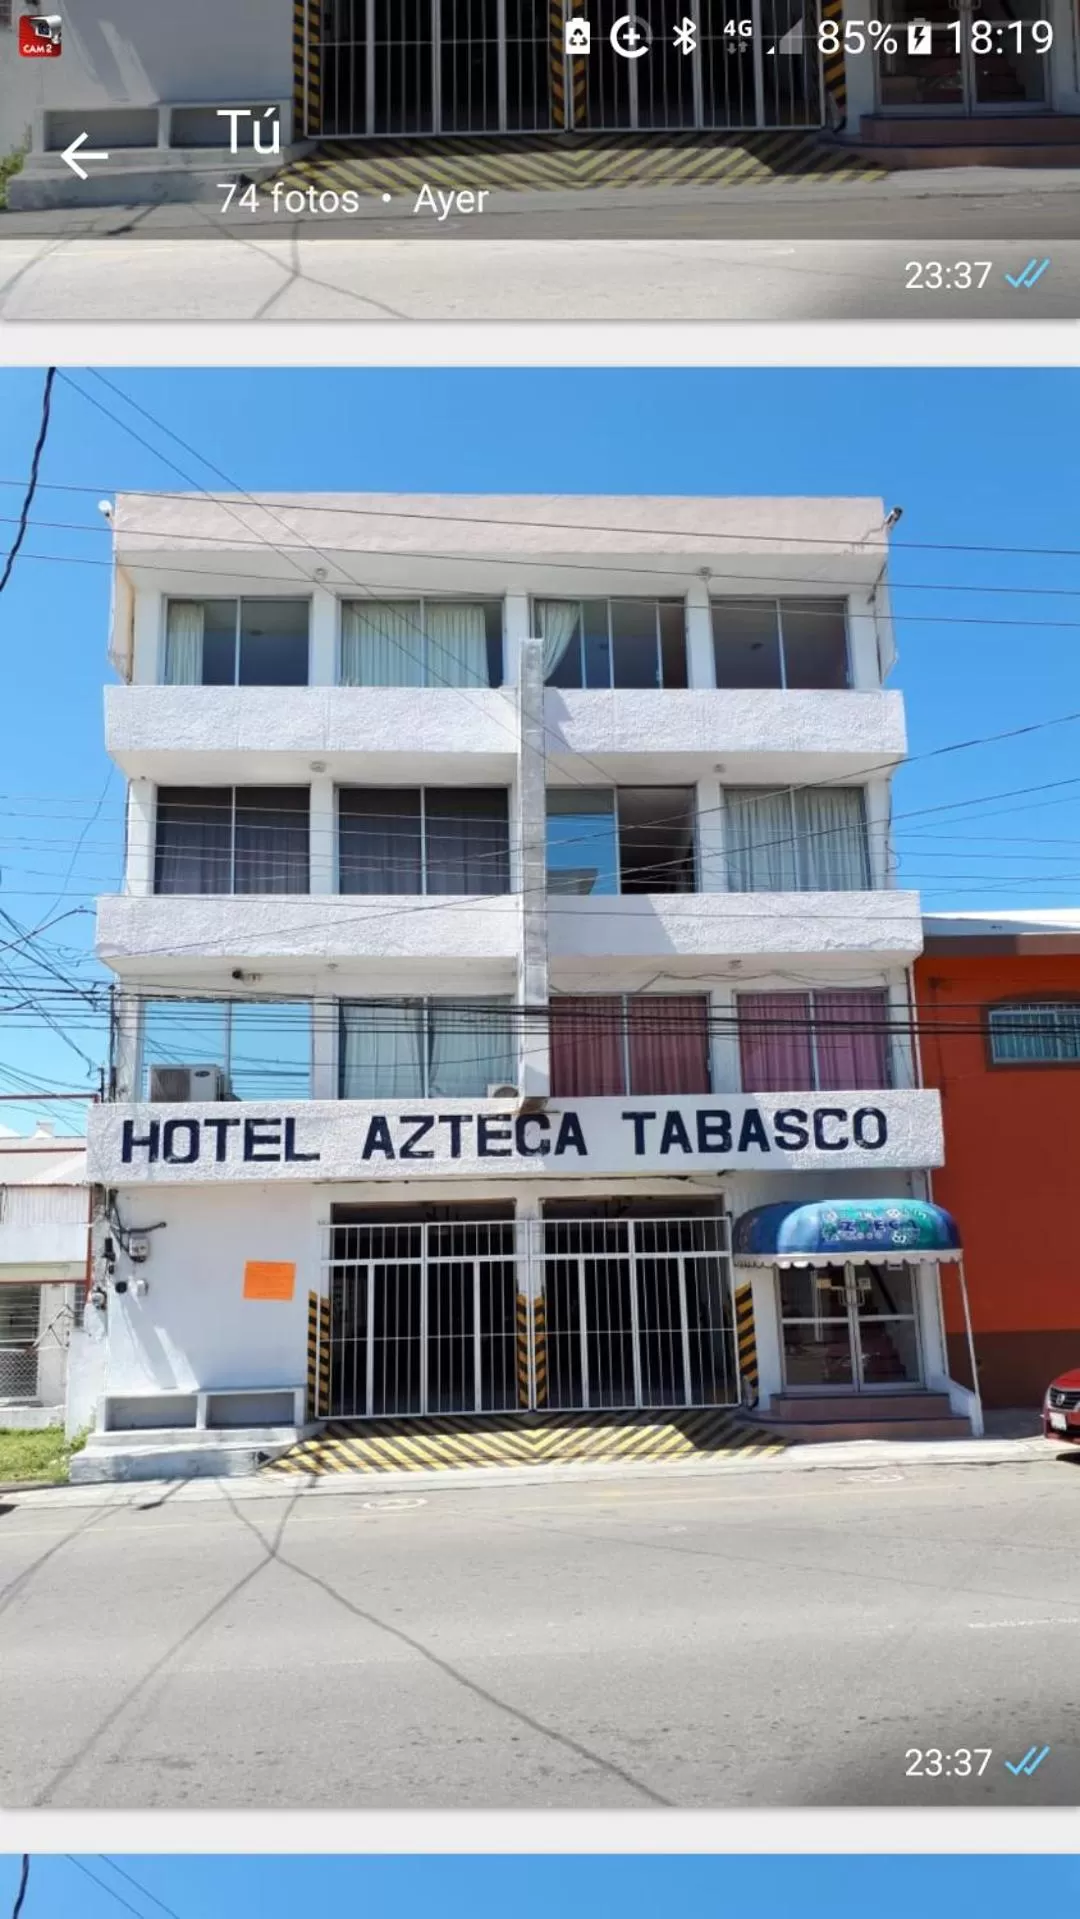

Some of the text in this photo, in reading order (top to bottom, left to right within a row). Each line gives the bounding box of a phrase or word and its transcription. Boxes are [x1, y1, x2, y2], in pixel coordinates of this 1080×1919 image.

[122, 1108, 887, 1163] HOTEL AZTECA TABASCO
